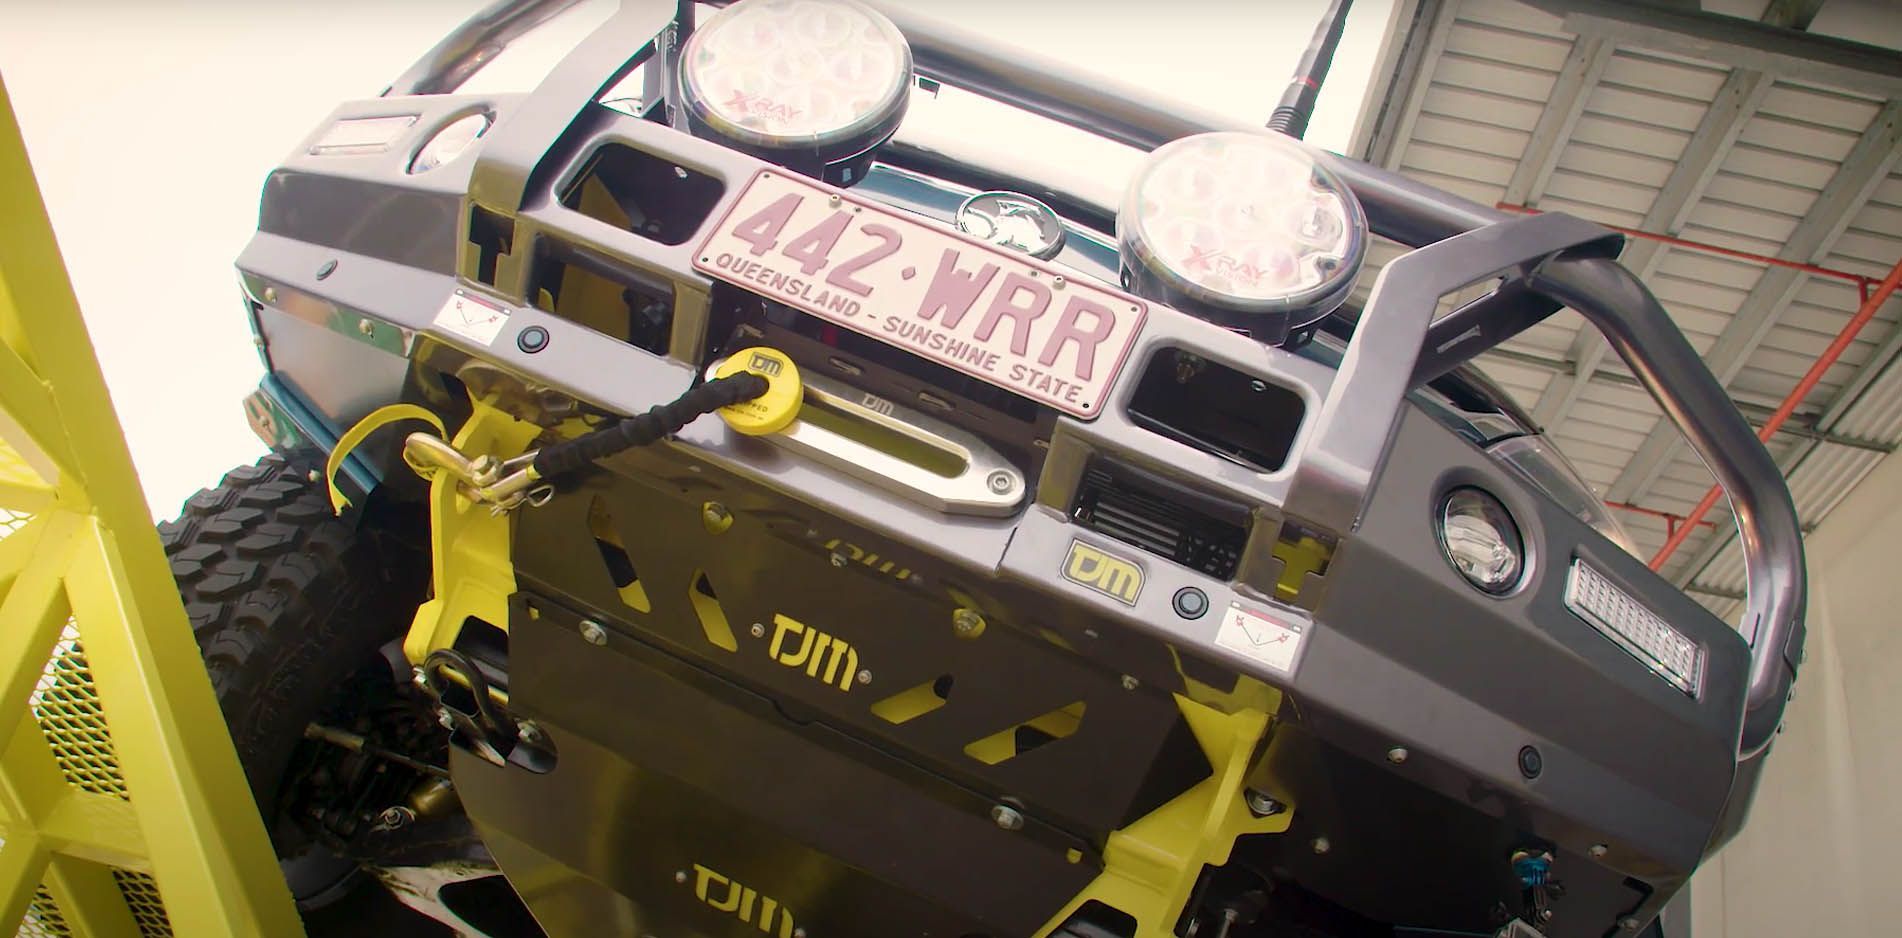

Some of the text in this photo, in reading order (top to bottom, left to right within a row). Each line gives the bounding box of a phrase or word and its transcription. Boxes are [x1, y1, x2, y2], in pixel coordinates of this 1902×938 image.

[715, 253, 861, 318] QUEENSLAND
[882, 316, 1002, 371] SUNSHINE
[1009, 364, 1084, 403] STATE
[751, 355, 782, 375] TJM
[862, 392, 894, 415] TJM
[1069, 543, 1142, 601] TJM
[769, 613, 859, 691] TJM
